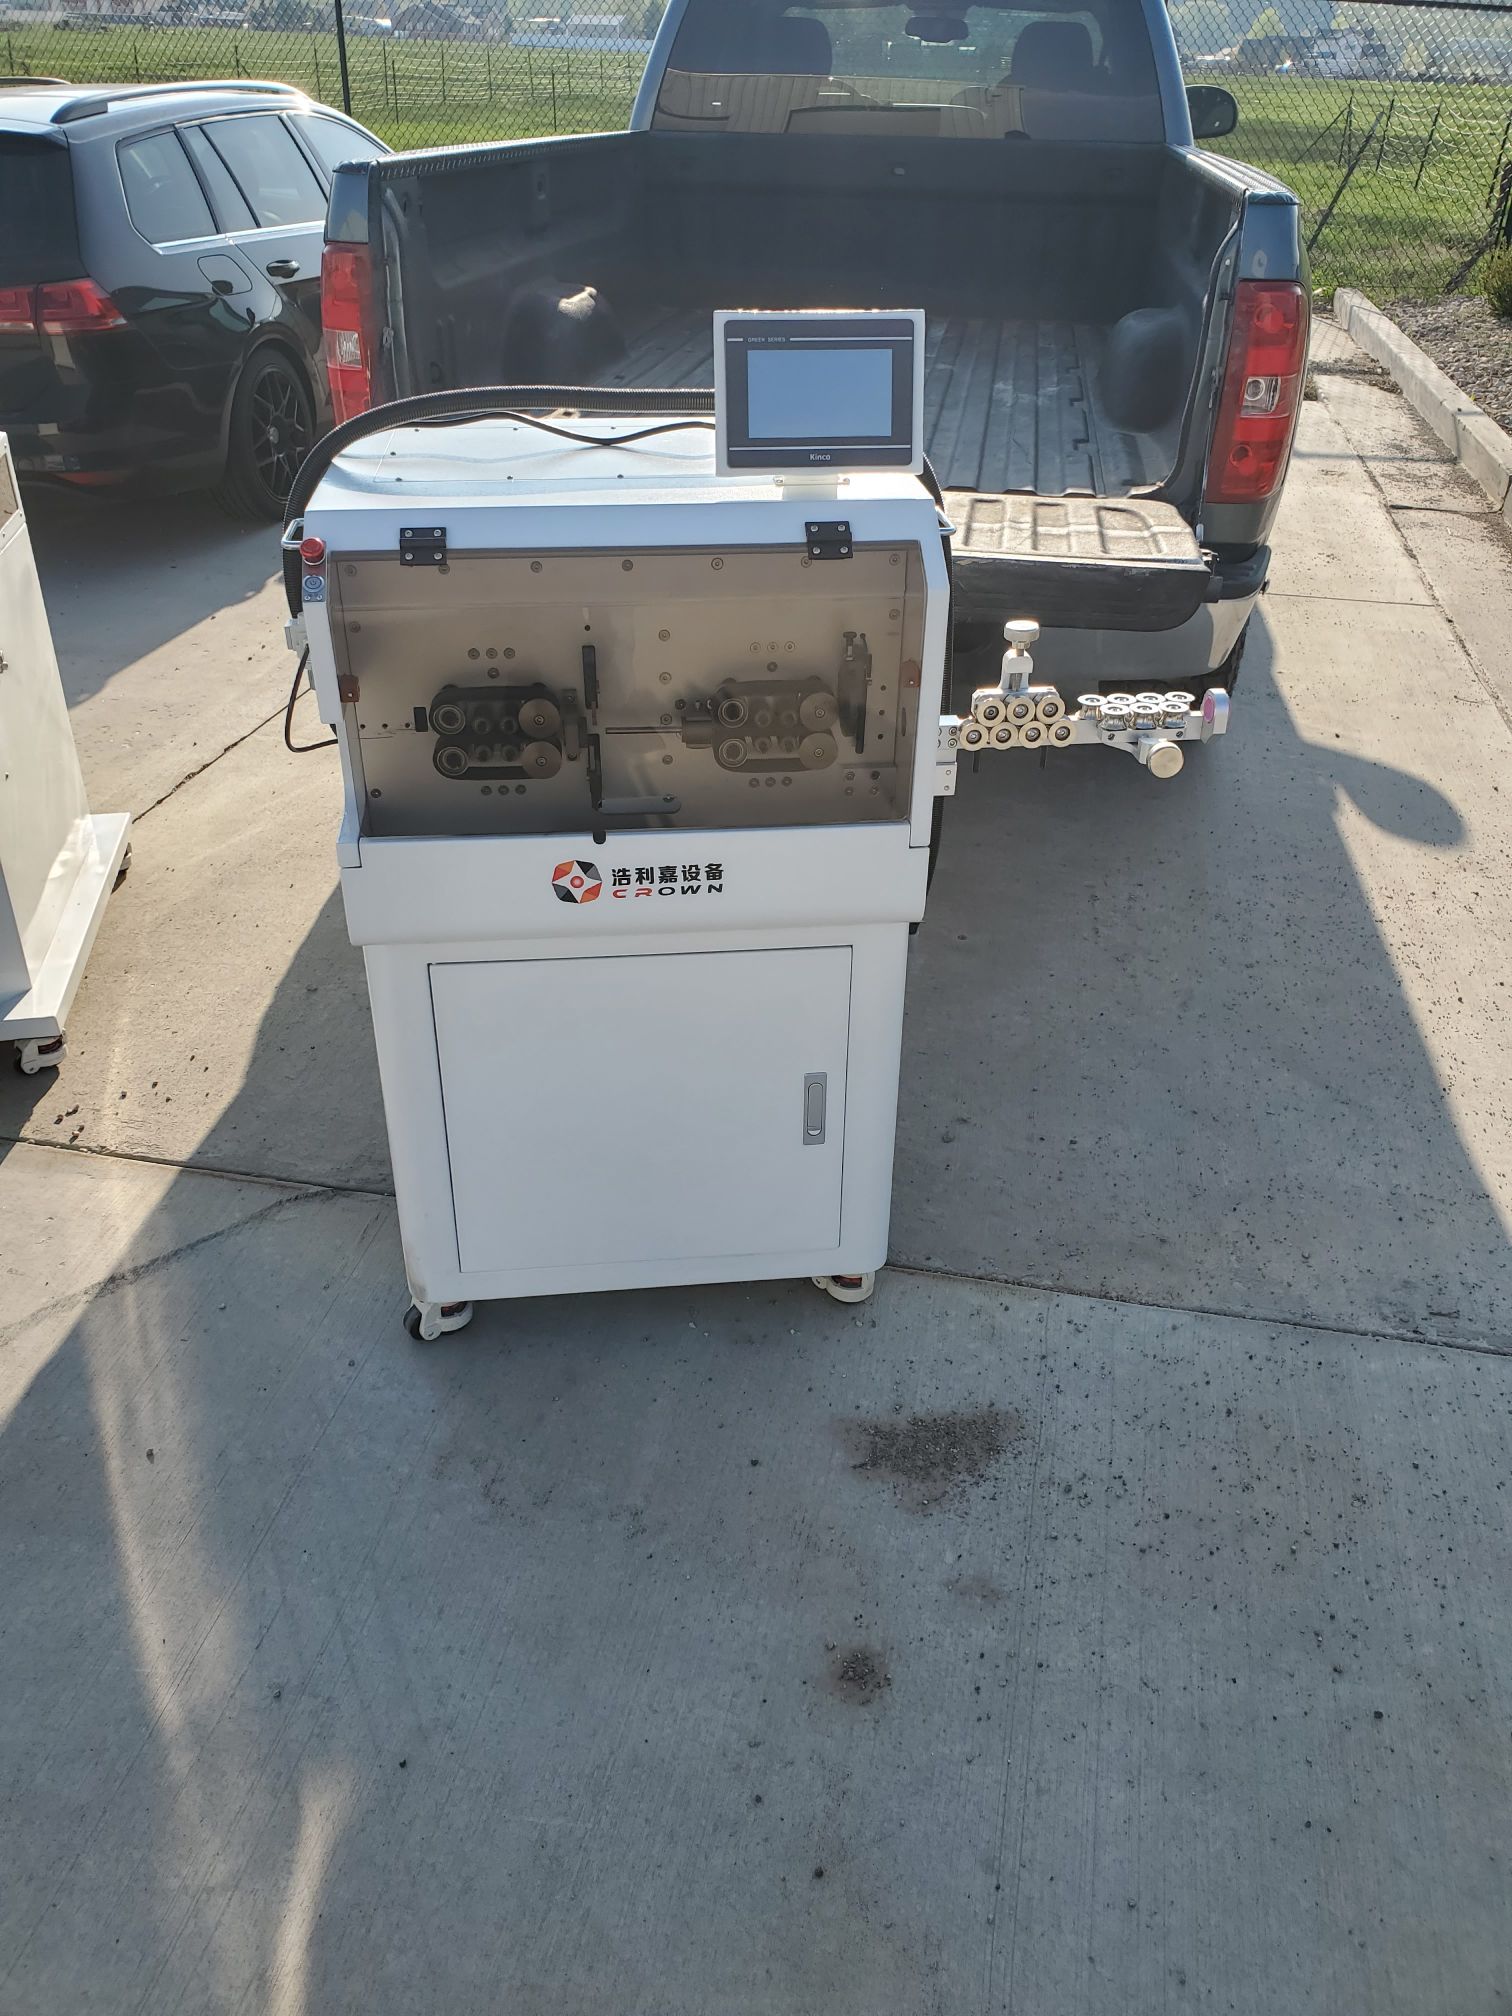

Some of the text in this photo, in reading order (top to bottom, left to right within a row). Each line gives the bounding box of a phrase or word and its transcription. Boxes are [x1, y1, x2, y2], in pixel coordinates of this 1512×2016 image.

[809, 453, 831, 461] Kinco
[611, 863, 724, 886] 浩利嘉设备
[612, 883, 723, 899] CROWN
